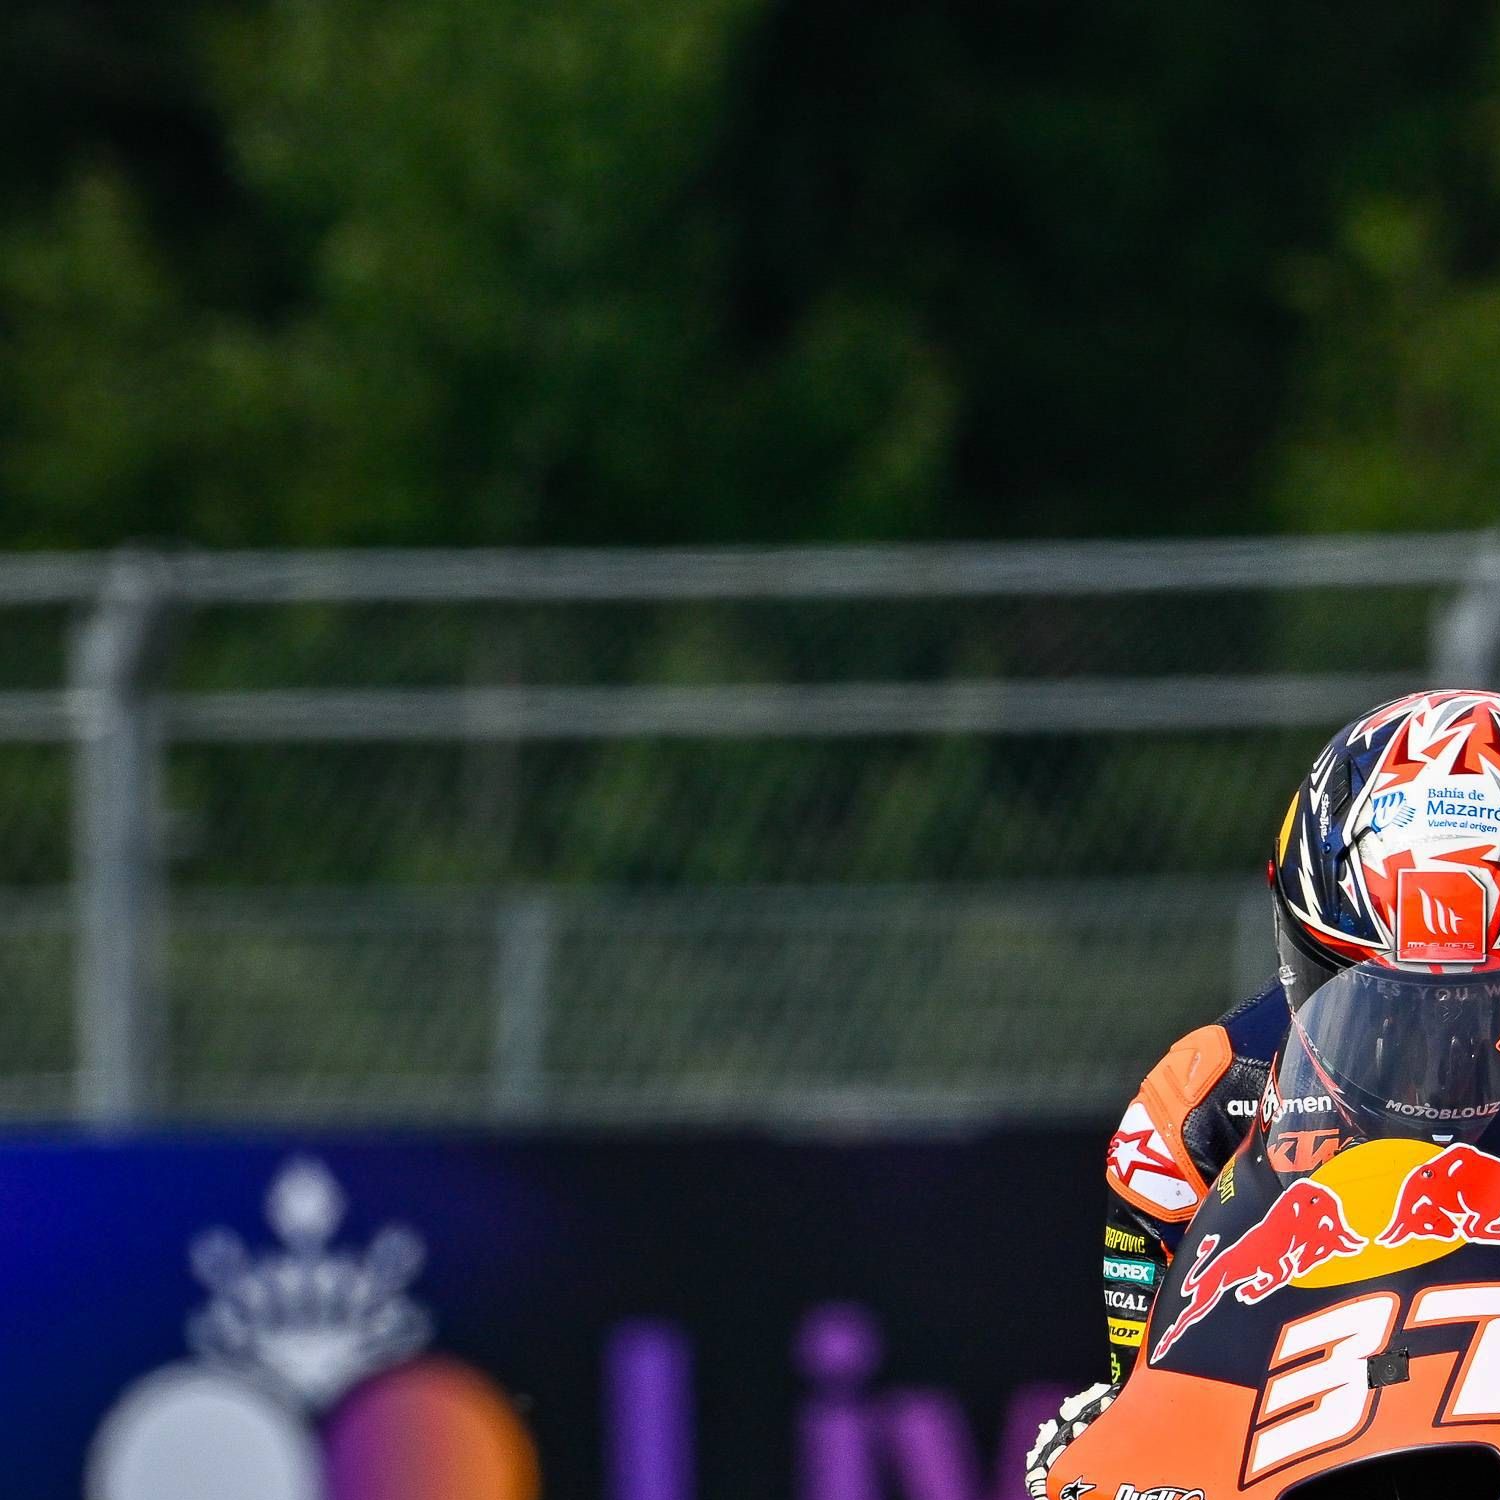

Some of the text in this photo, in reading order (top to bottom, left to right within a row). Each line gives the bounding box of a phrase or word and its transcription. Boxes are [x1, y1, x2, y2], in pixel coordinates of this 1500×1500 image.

[1428, 788, 1485, 801] Bahía de
[1428, 820, 1458, 828] Vuelve
[1469, 822, 1498, 833] origen
[1420, 986, 1469, 1001] YOU
